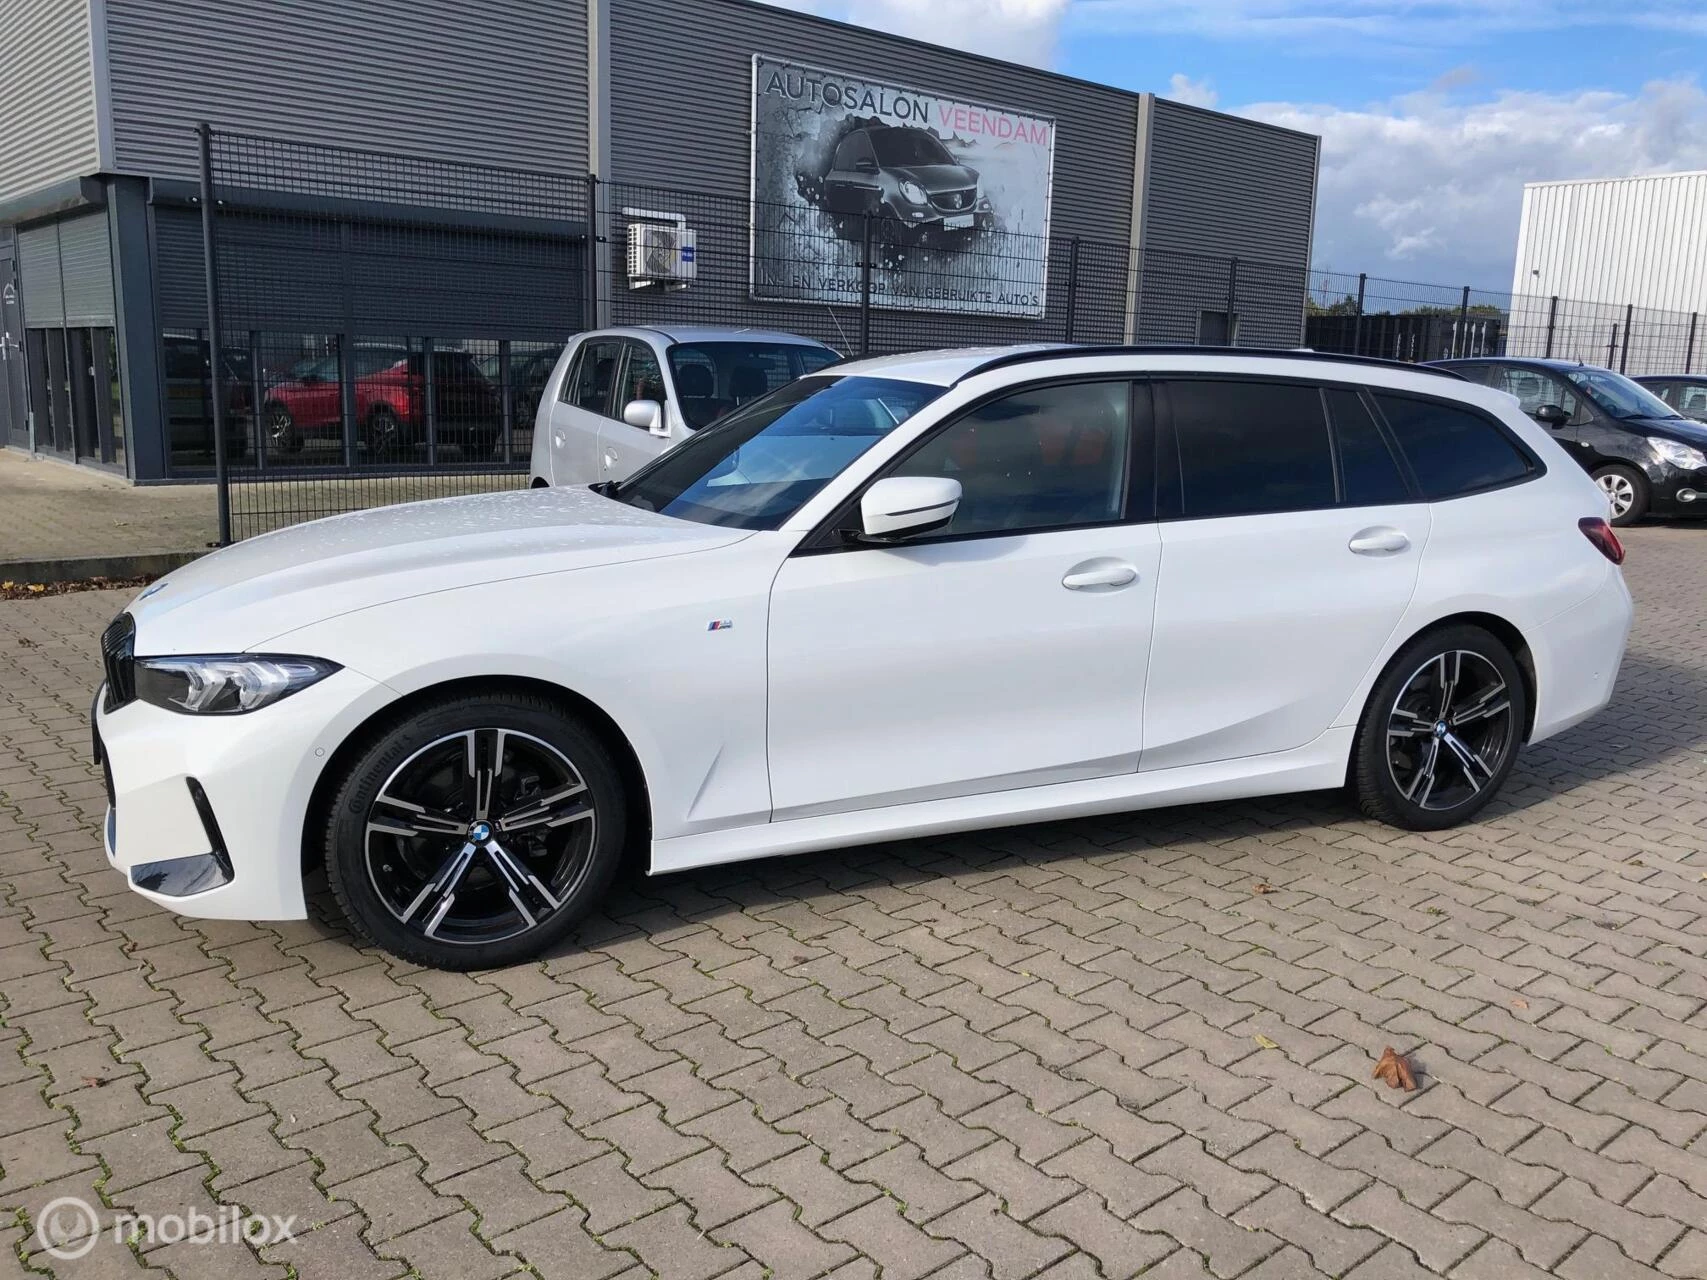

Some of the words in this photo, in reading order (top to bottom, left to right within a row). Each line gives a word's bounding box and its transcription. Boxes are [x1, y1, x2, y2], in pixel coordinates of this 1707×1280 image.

[763, 70, 929, 124] AUTOSALON
[938, 103, 1047, 146] VEENDAM
[792, 275, 811, 289] EN
[892, 286, 918, 298] VAN
[925, 287, 993, 303] GEBRUIKTE
[998, 291, 1038, 306] AUTO'S
[348, 740, 403, 814] Continental
